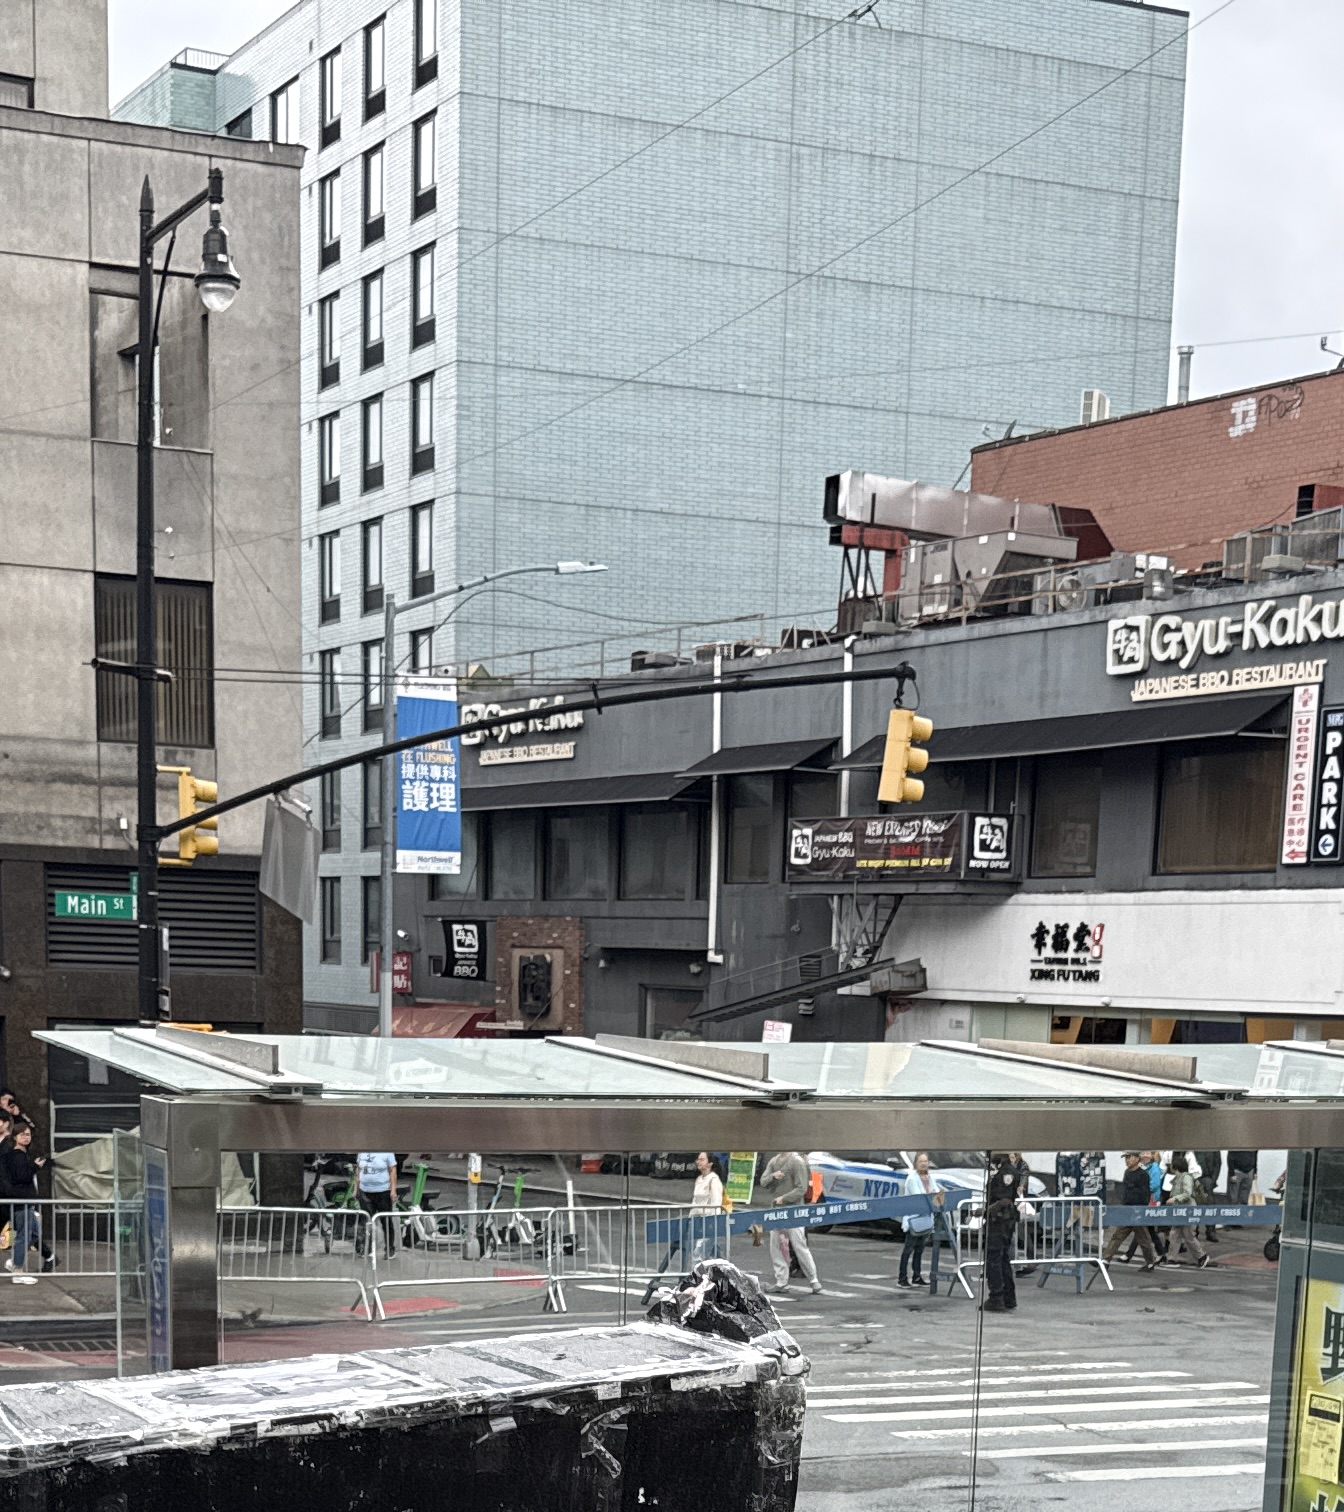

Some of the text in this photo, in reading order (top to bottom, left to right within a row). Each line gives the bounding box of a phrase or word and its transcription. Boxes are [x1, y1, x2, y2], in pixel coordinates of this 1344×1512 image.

[1130, 659, 1328, 698] JAPANESE BBQ RESTAURANT
[1294, 717, 1311, 769] URGENT
[1291, 772, 1307, 812] CARE
[1318, 731, 1343, 831] PARK
[402, 781, 457, 812] 護理
[812, 847, 855, 860] Gyu-Kaku
[67, 894, 125, 915] Main St
[453, 966, 479, 977] BBQ
[1029, 968, 1100, 982] XING FU TANG
[862, 1178, 901, 1198] NYPD
